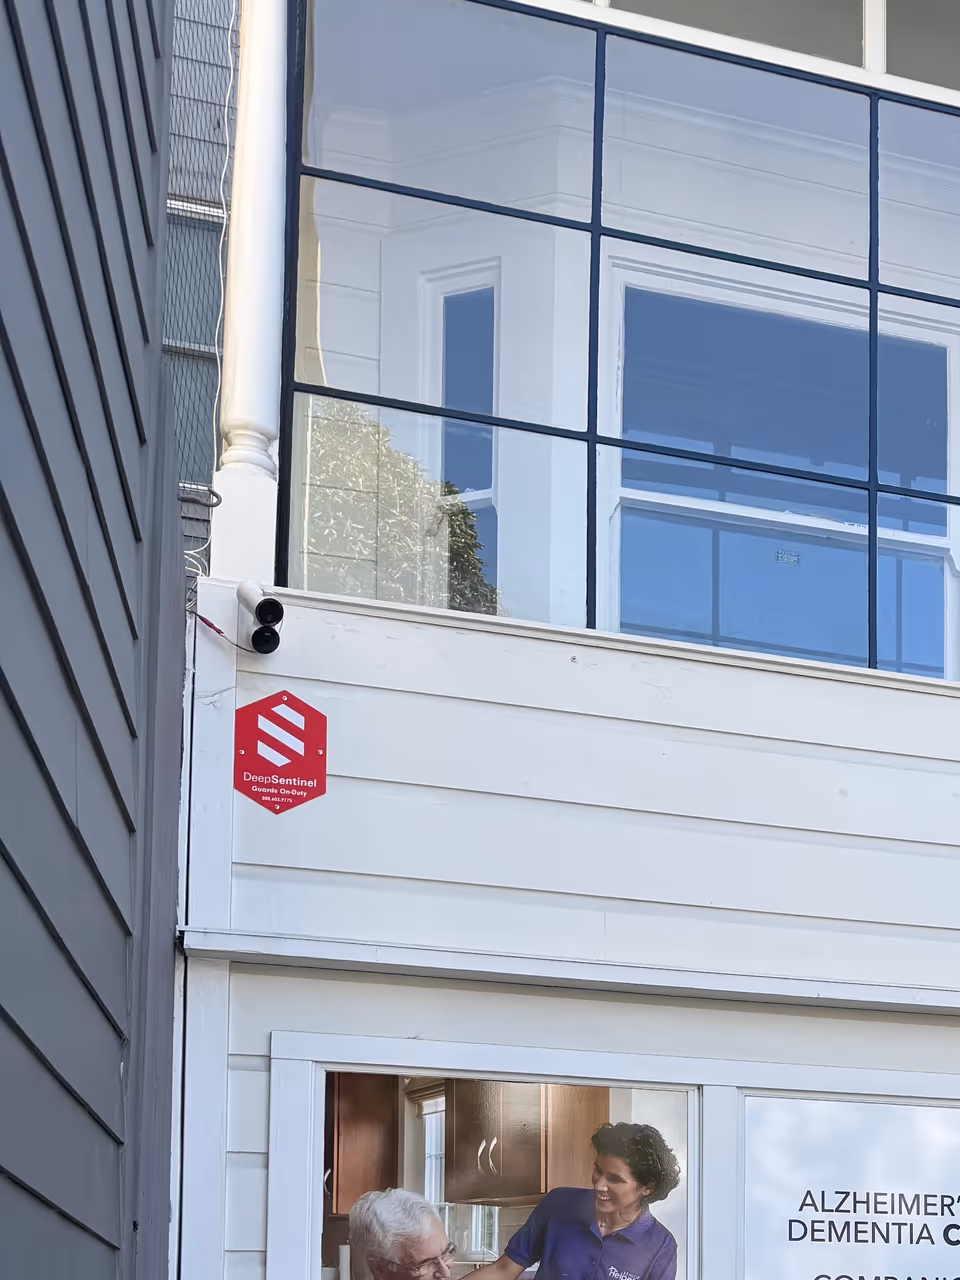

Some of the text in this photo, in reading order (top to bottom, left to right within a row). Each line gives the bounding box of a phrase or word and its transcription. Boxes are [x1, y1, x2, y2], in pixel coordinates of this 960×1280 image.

[243, 771, 317, 788] DeepSentinel
[251, 785, 308, 797] Guards On-Duty
[788, 1219, 935, 1245] DEMENTIA
